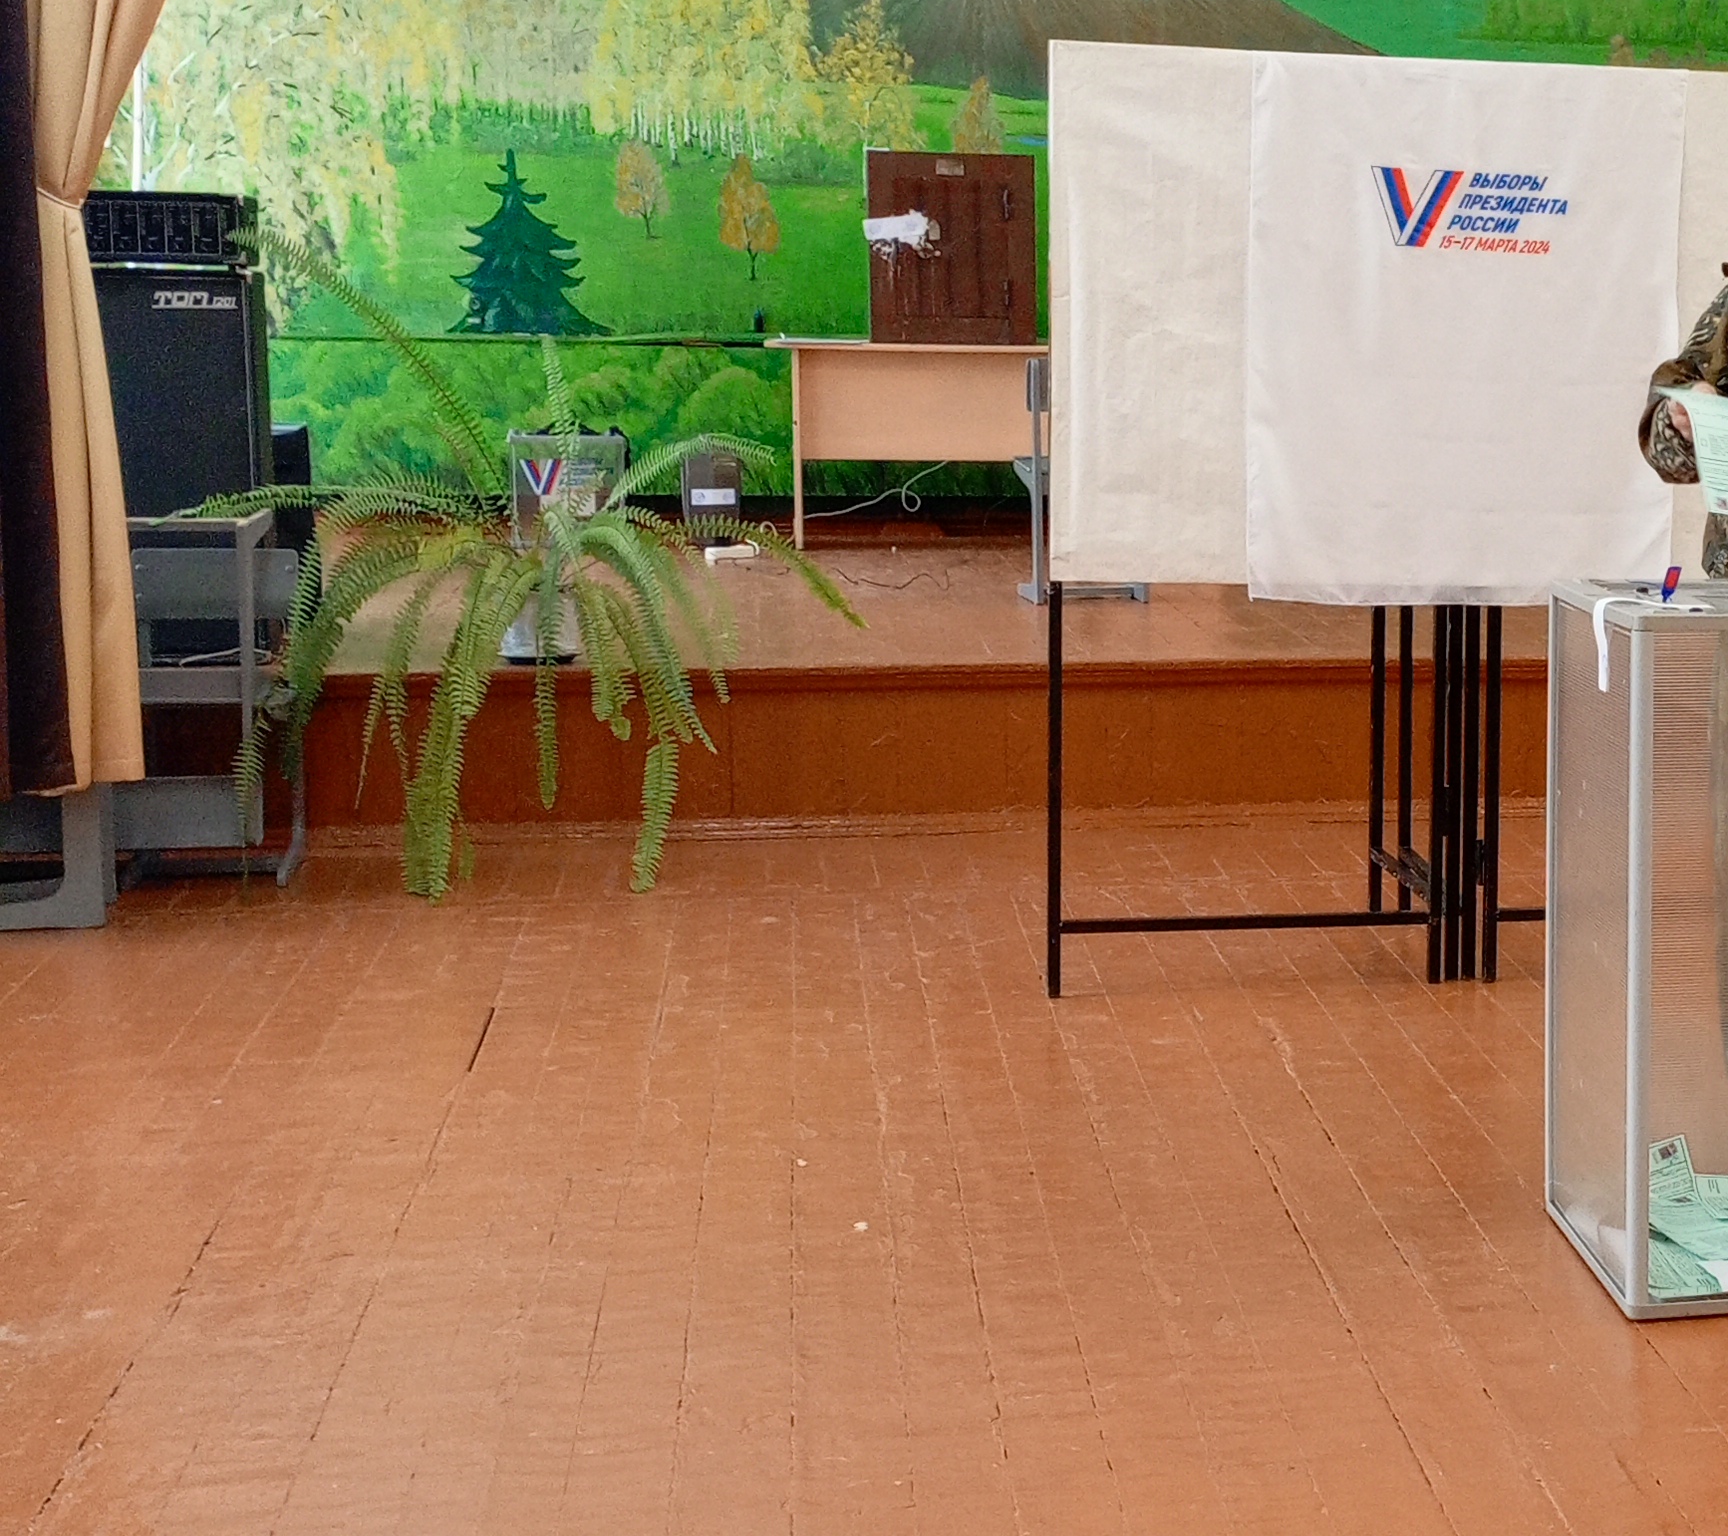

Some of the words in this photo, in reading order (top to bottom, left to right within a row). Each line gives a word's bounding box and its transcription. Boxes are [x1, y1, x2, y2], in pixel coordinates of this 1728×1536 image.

[1468, 172, 1549, 192] ВЫБОРЫ
[1457, 194, 1569, 216] ПРЕЗИДЕНТА
[1446, 215, 1520, 233] РОССИИ
[1474, 237, 1518, 253] МАРТА
[1518, 240, 1551, 255] 2024
